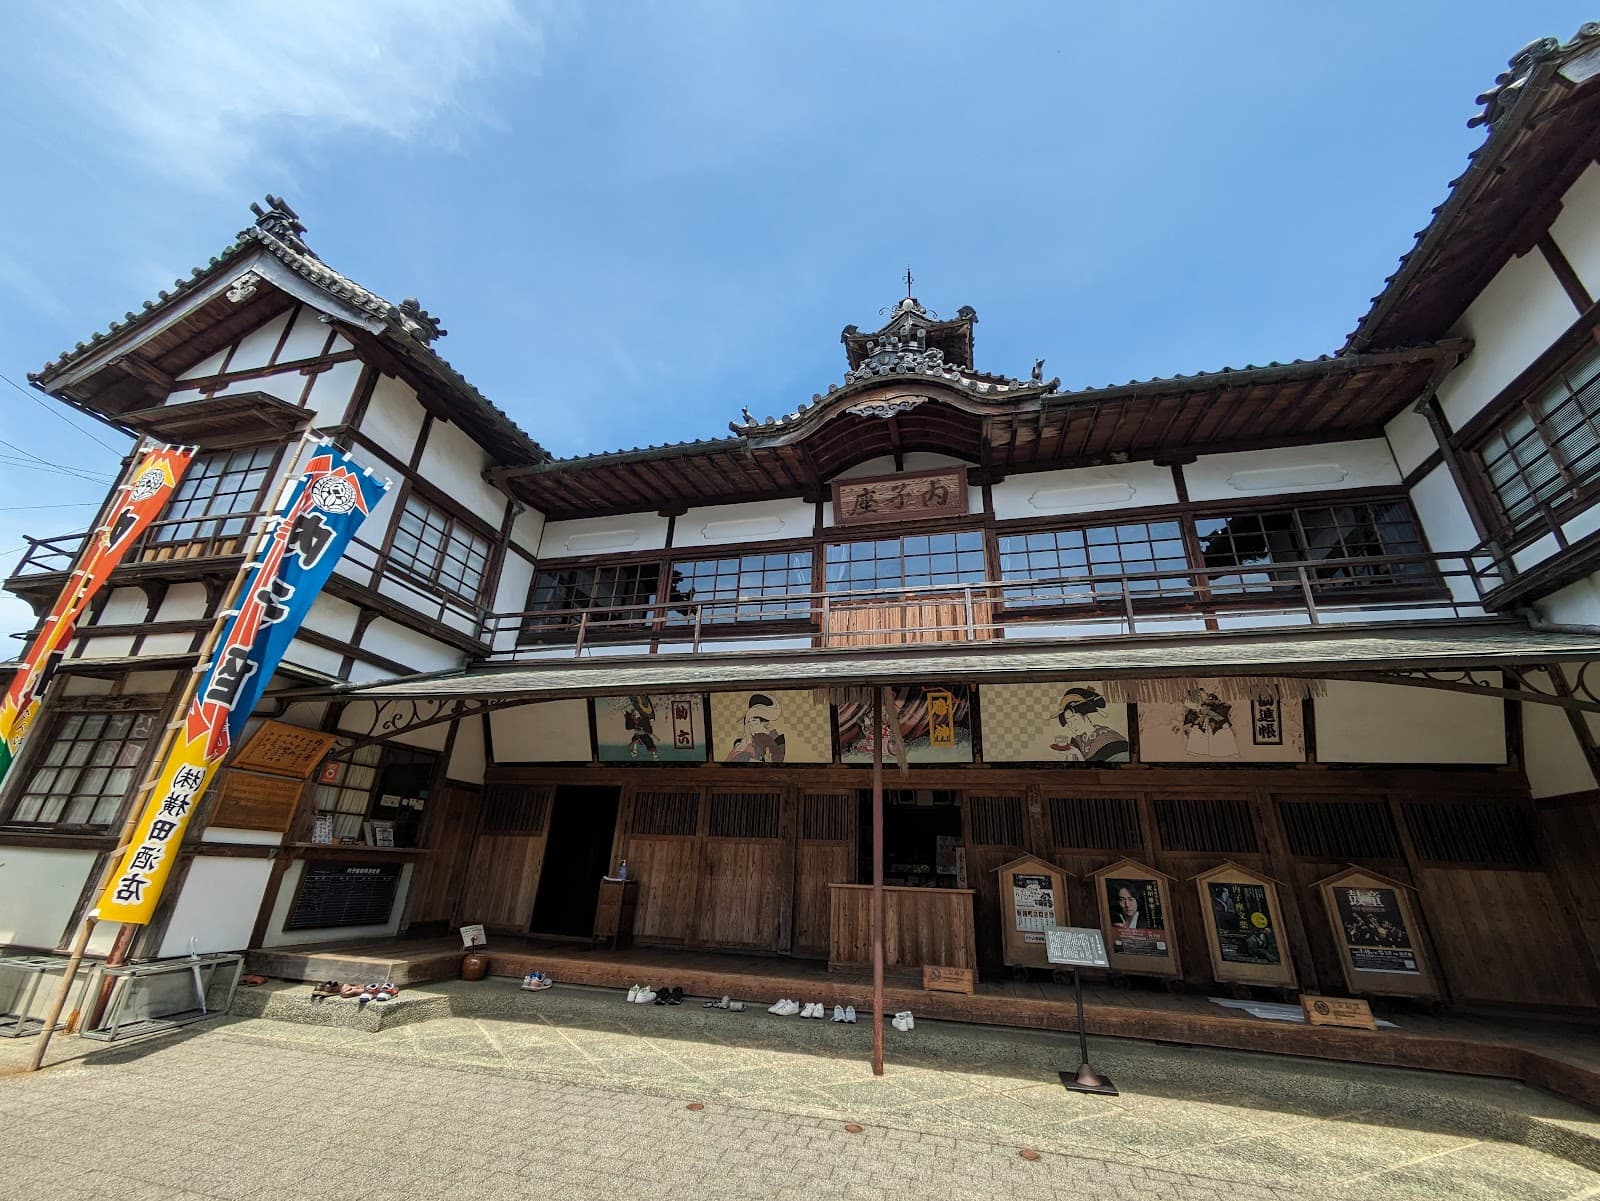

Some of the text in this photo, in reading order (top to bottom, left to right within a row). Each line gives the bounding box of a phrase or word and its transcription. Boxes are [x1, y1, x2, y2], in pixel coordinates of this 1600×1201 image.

[846, 480, 949, 516] 内子座
[676, 704, 690, 745] 助六
